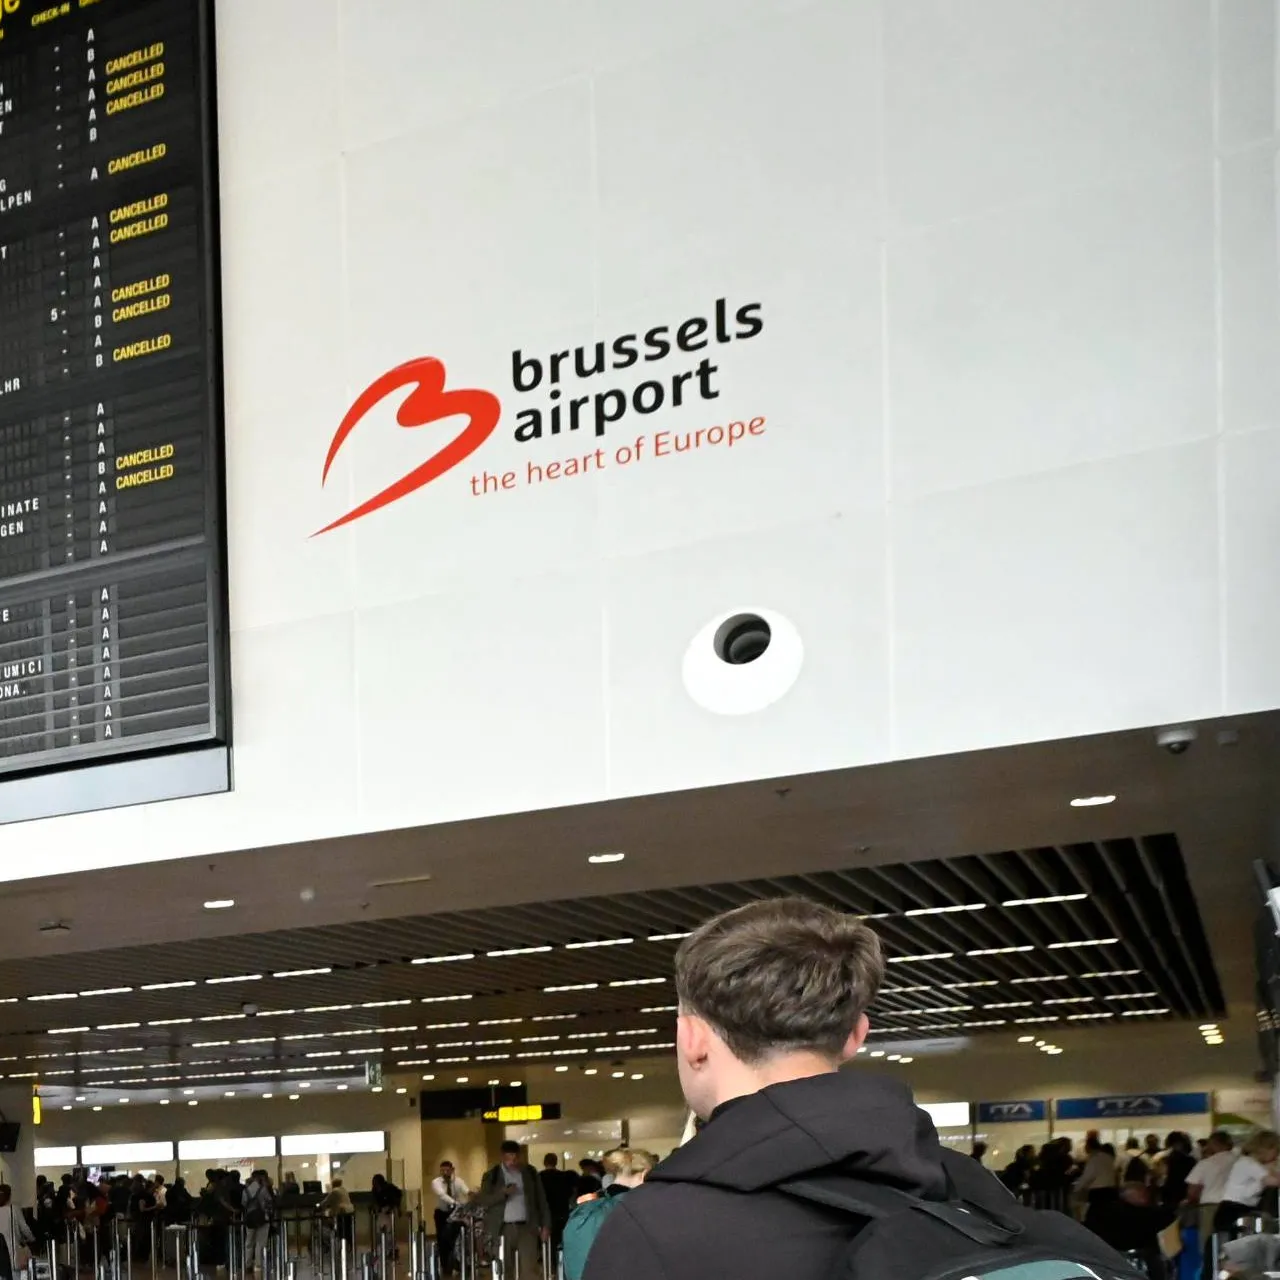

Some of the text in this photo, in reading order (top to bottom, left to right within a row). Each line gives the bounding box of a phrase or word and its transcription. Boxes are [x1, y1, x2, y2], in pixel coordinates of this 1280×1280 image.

[31, 2, 70, 26] CHECK-IN
[106, 42, 163, 74] CANCELLED
[108, 143, 165, 174] CANCELLED
[110, 193, 167, 223] CANCELLED
[111, 274, 169, 302] CANCELLED
[113, 334, 170, 361] CANCELLED
[512, 298, 763, 392] brussels
[514, 358, 720, 442] airport
[116, 444, 173, 469] CANCELLED
[470, 416, 765, 496] the heart of Europe
[116, 464, 173, 489] CANCELLED
